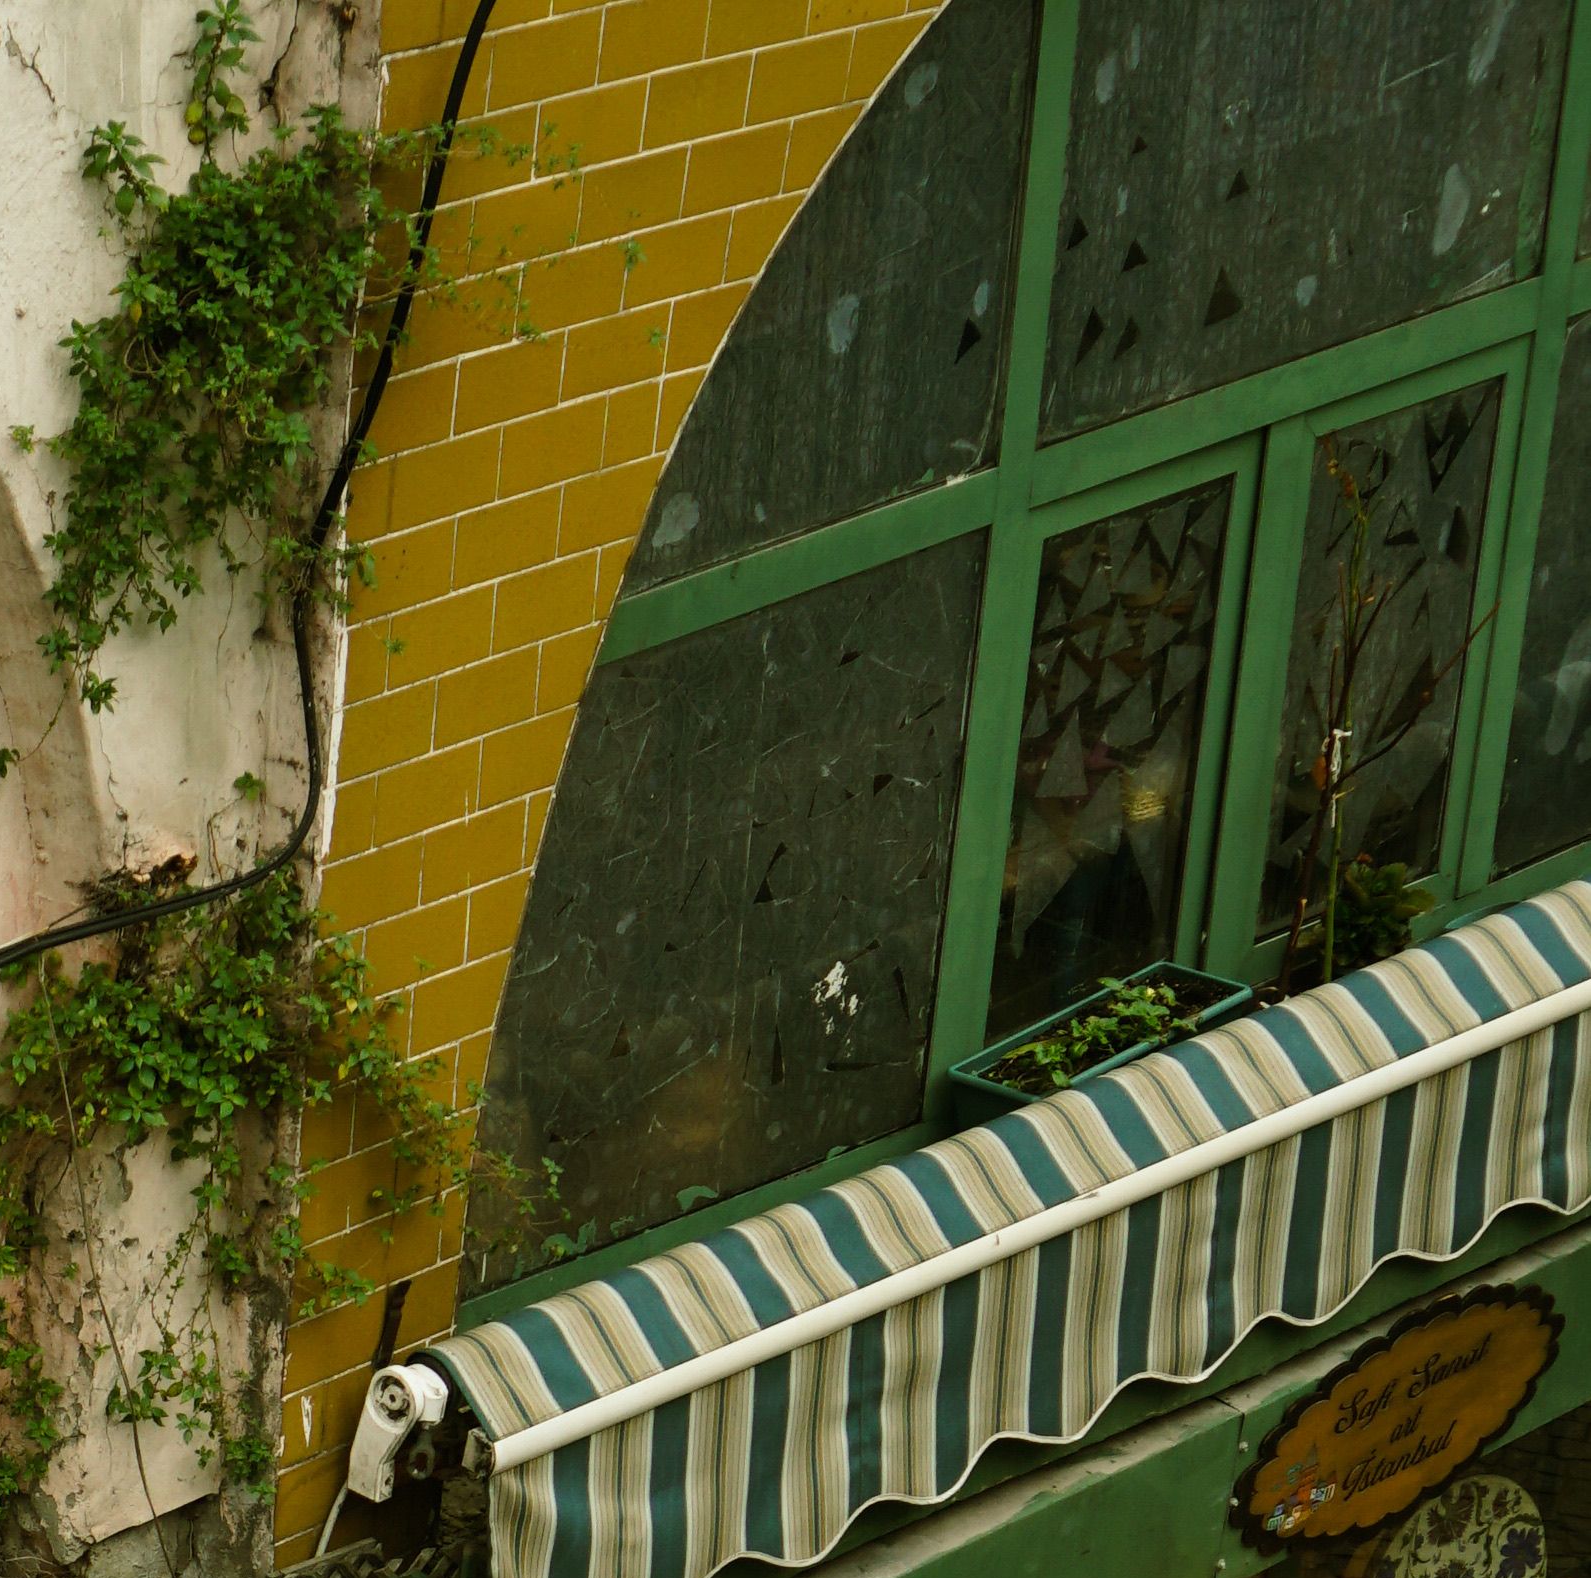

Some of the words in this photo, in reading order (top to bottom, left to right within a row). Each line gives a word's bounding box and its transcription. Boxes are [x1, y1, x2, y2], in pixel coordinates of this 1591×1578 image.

[1334, 1378, 1400, 1434] Safi
[1407, 1332, 1492, 1398] Sanat
[1389, 1406, 1423, 1443] art
